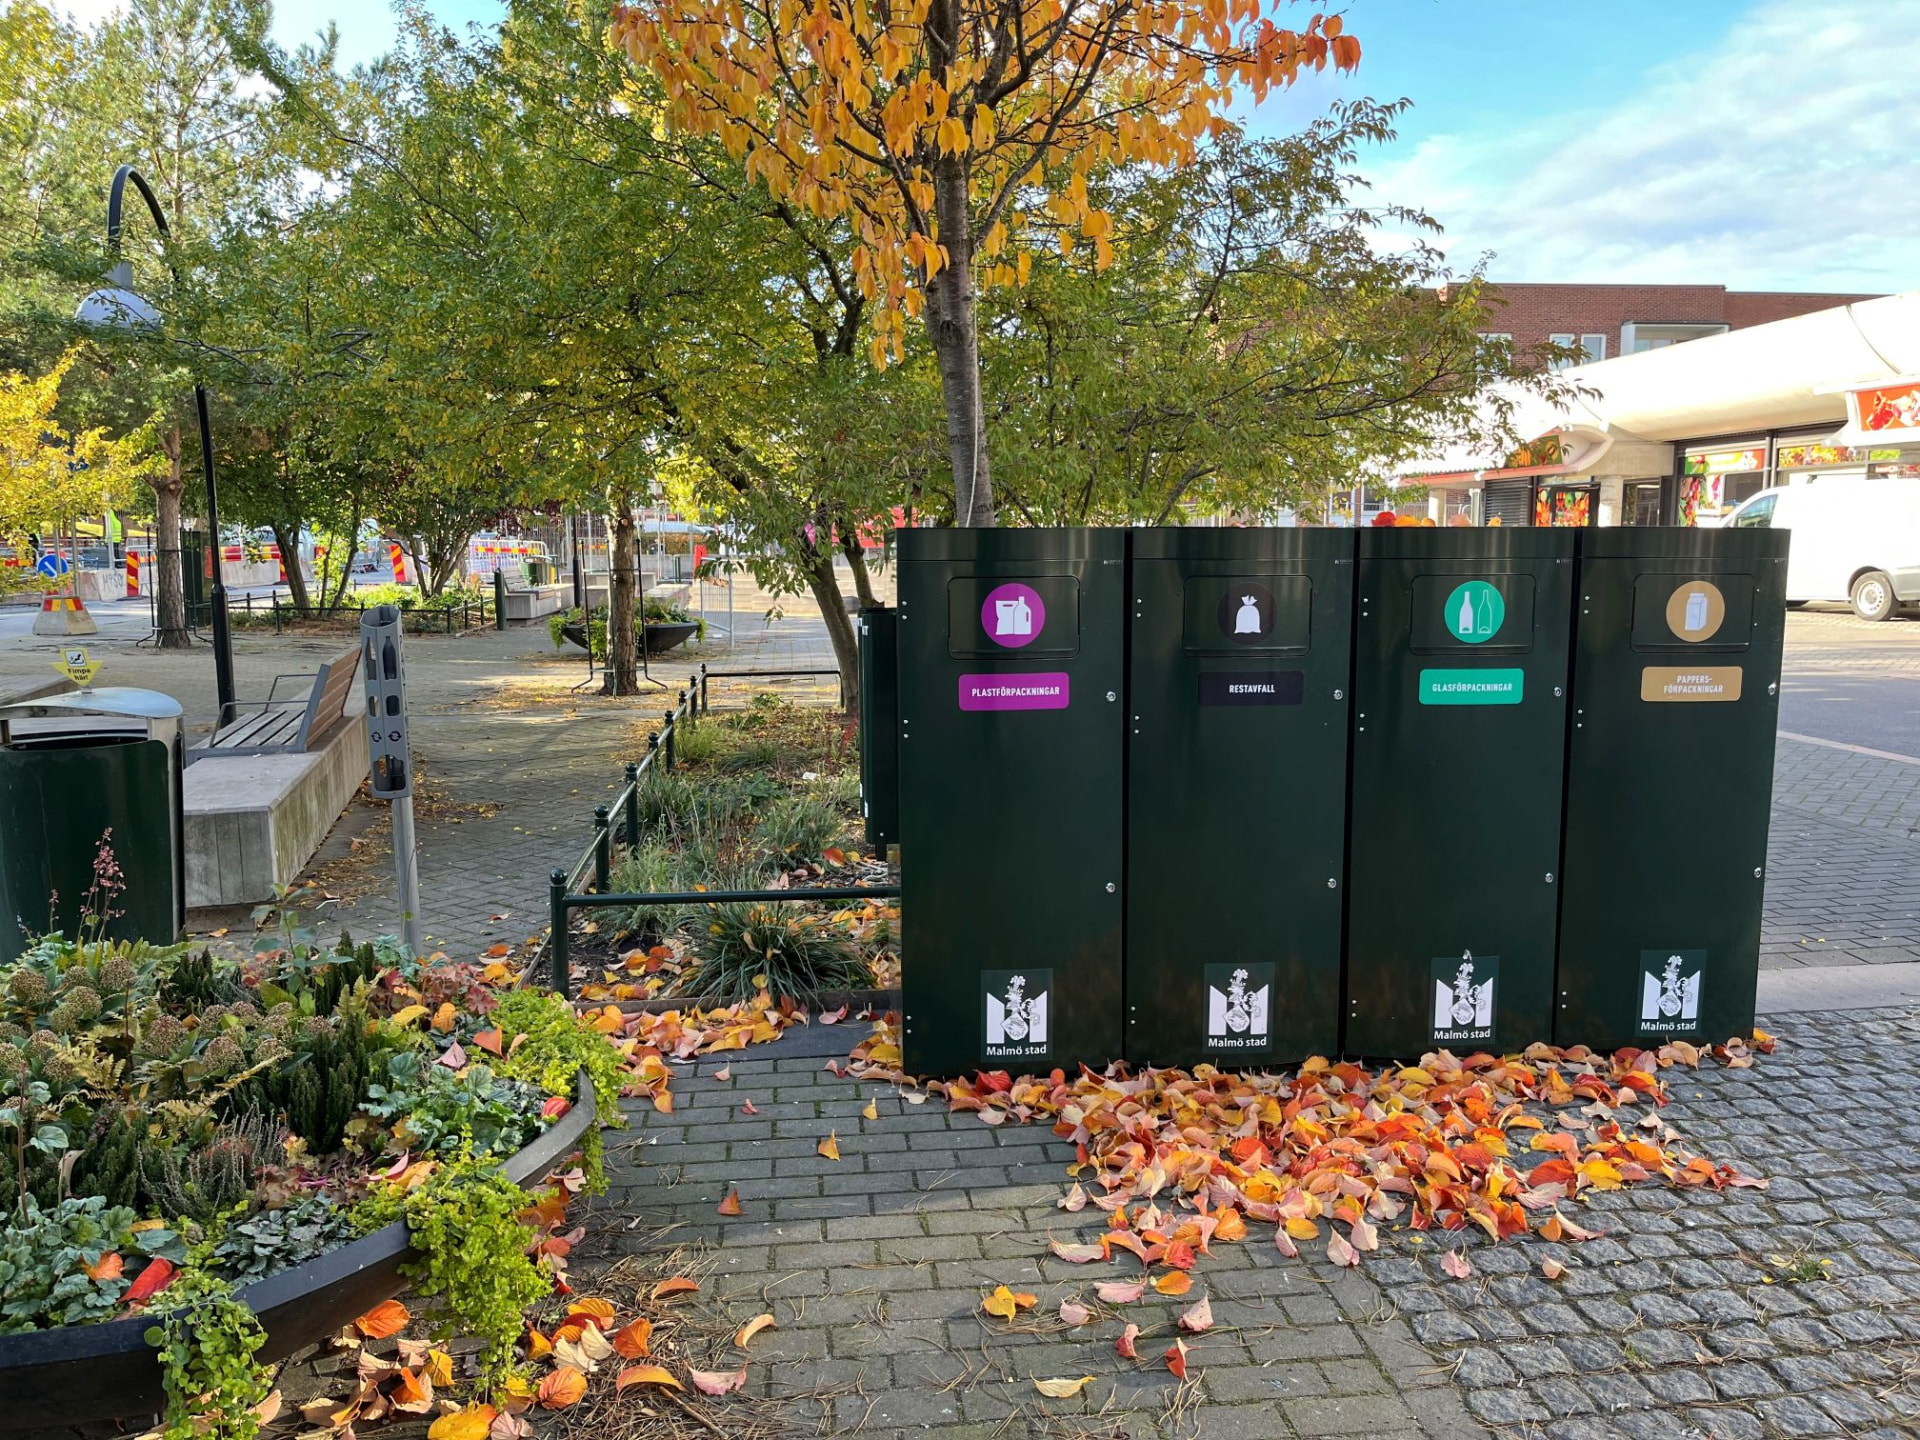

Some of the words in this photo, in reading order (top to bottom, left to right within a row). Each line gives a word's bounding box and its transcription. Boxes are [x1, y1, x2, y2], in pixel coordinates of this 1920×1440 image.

[1676, 675, 1713, 684] PAPPERS-
[971, 686, 1060, 697] PLASTFÖRPACKNINGAR
[1228, 684, 1276, 694] RESTAVFALL
[1432, 682, 1513, 692] GLASFÖRPACKNINGAR
[1663, 684, 1723, 694] FÖRPACKNINGAR
[1640, 1021, 1675, 1031] Malmö
[1676, 1020, 1697, 1031] stad
[1433, 1029, 1469, 1040] Malmö
[1470, 1028, 1491, 1038] stad
[1208, 1037, 1244, 1048] Malmö
[1245, 1036, 1268, 1047] stad
[986, 1045, 1023, 1056] Malmö
[1024, 1044, 1047, 1055] stad
